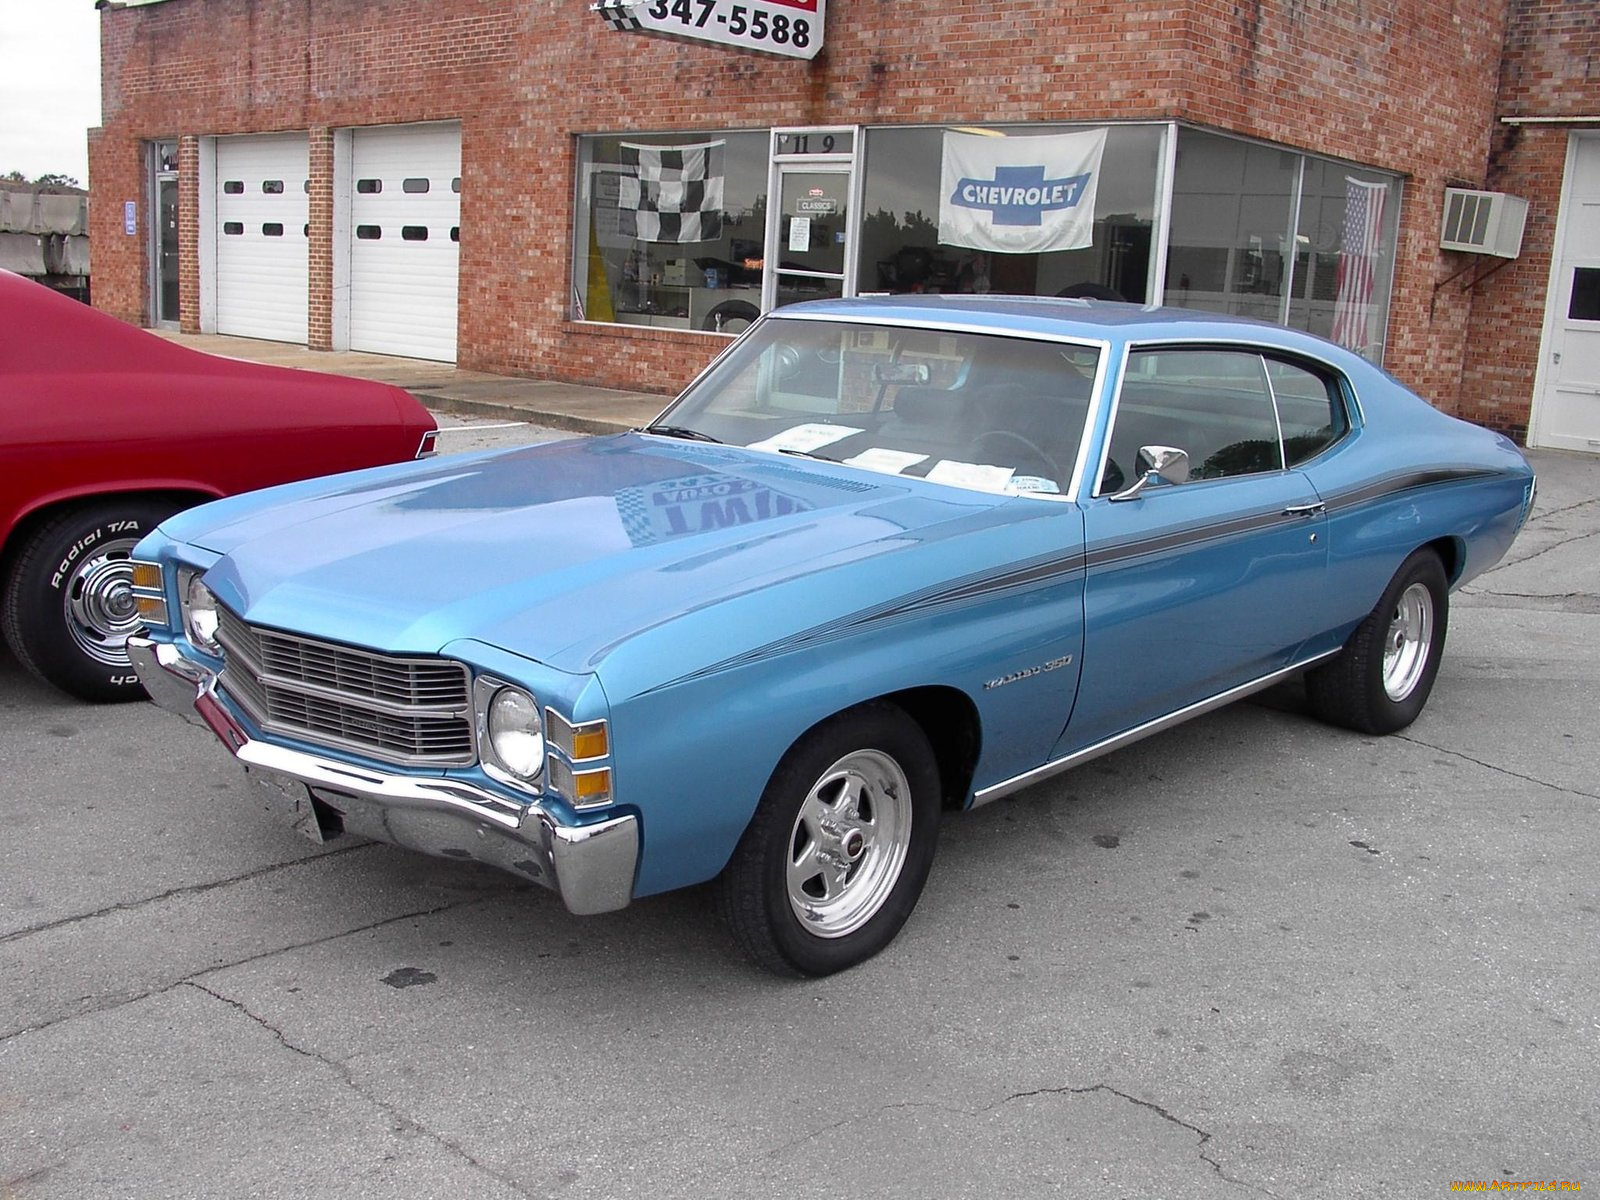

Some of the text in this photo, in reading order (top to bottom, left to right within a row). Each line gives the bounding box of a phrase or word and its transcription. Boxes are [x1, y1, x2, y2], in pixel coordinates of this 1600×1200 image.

[648, 0, 810, 48] 347-5588
[801, 201, 831, 210] CLASSICS
[962, 183, 1077, 206] CHEVROLET
[51, 520, 139, 589] Radial T/A
